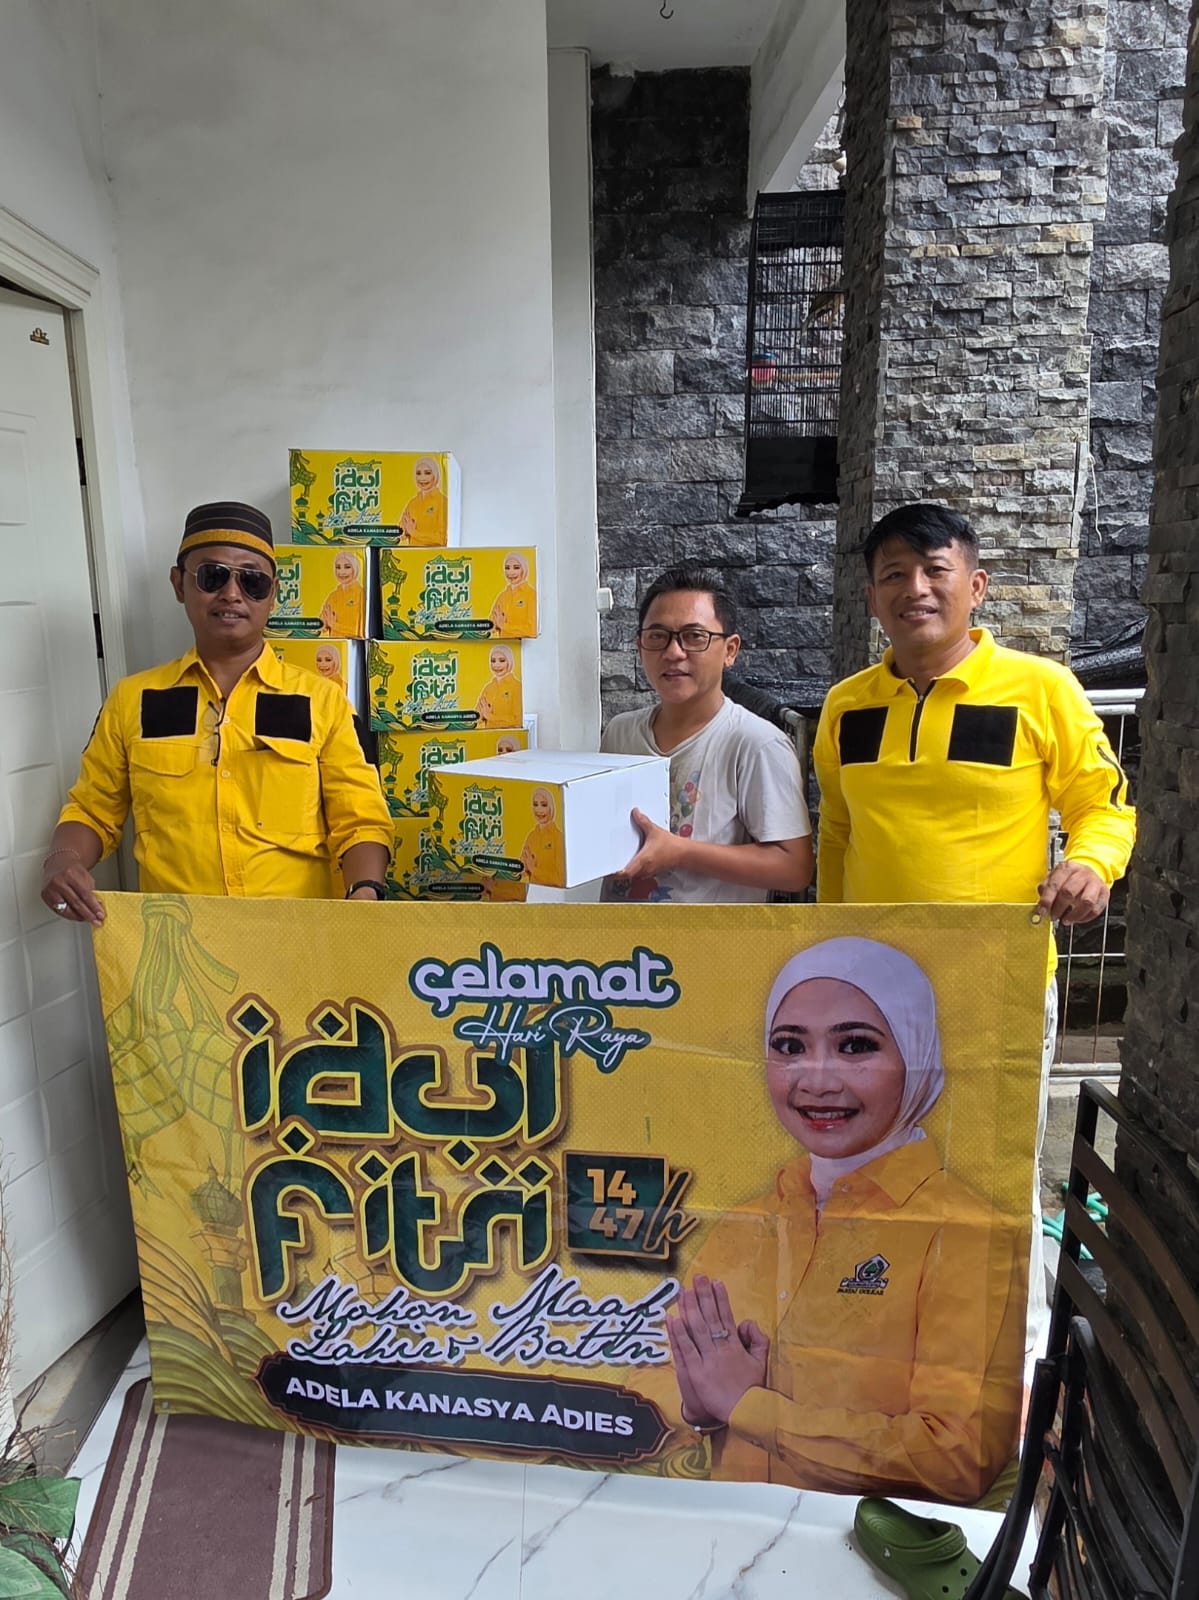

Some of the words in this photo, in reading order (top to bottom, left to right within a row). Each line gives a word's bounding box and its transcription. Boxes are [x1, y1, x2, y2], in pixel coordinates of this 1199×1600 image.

[459, 1004, 546, 1061] Hari
[549, 1005, 646, 1068] Raya
[586, 1168, 637, 1205] 14
[279, 1278, 473, 1324] Mohon
[492, 1267, 676, 1320] Maaf
[290, 1318, 443, 1361] Lahir
[485, 1313, 666, 1361] Batin
[286, 1375, 381, 1410] ADELA
[384, 1389, 533, 1424] KANASYA
[540, 1403, 634, 1436] ADIES
